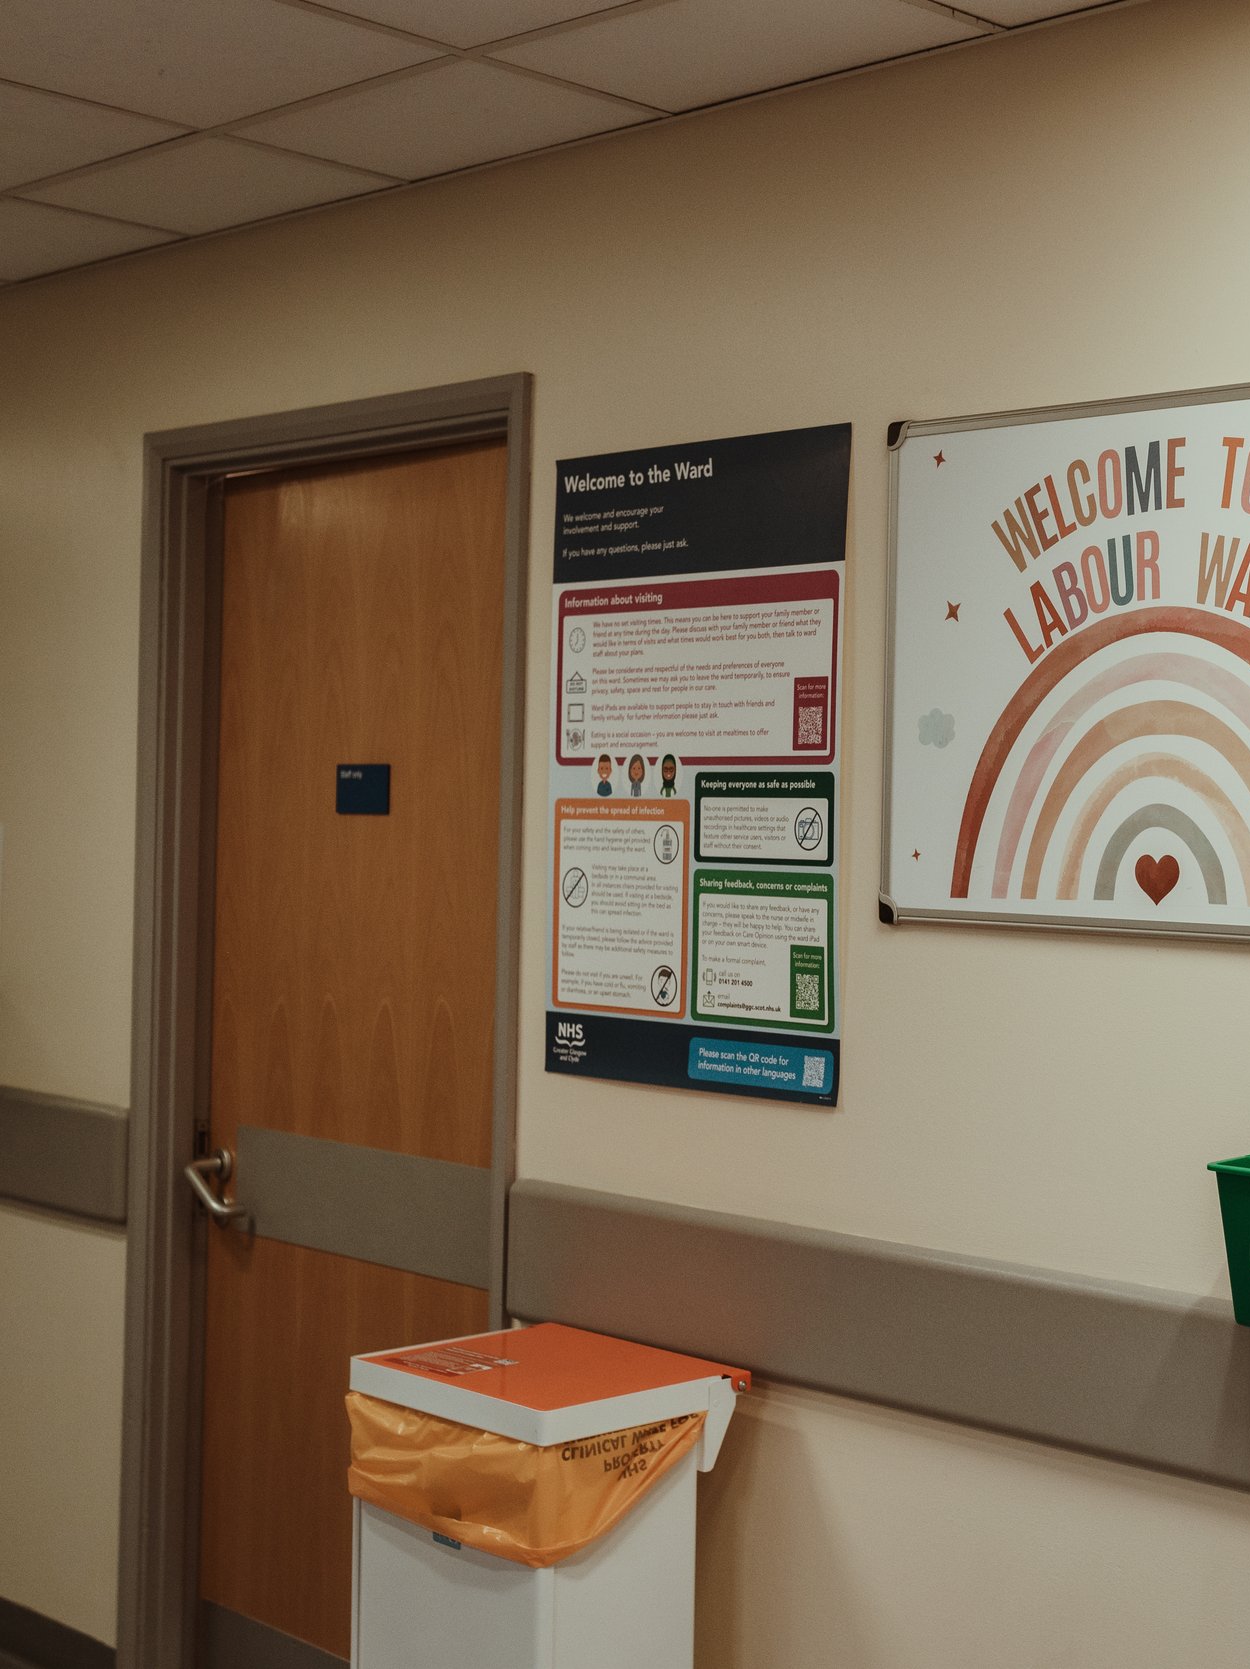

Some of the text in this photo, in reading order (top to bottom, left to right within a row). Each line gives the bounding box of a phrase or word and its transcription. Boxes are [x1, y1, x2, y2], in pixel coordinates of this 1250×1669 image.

[564, 458, 712, 492] Welcome to the Ward
[574, 512, 601, 521] welcome
[602, 509, 614, 518] and
[615, 508, 648, 517] encourage
[649, 506, 664, 516] your
[991, 436, 1186, 573] WELCOME
[563, 521, 639, 534] involvement and support.
[562, 548, 567, 557] If
[568, 550, 579, 559] you
[596, 547, 607, 556] any
[608, 544, 639, 554] questions,
[641, 541, 661, 552] please
[662, 540, 674, 551] just
[676, 538, 688, 547] ask.
[564, 593, 662, 607] Information about visiting
[1002, 530, 1160, 665] LABOUR
[701, 779, 726, 790] Keeping
[728, 781, 757, 790] everyone
[766, 779, 779, 788] safe
[789, 779, 815, 790] possible
[561, 806, 574, 814] Help
[610, 807, 630, 815] spread
[699, 878, 722, 889] Sharing
[724, 879, 754, 889] feedback,
[793, 883, 827, 892] complaints
[558, 1022, 584, 1040] NHS
[699, 1047, 719, 1058] Please
[736, 1051, 747, 1061] the
[748, 1052, 759, 1062] QR
[760, 1055, 777, 1064] code
[778, 1055, 789, 1065] for
[697, 1061, 796, 1080] information in other languages
